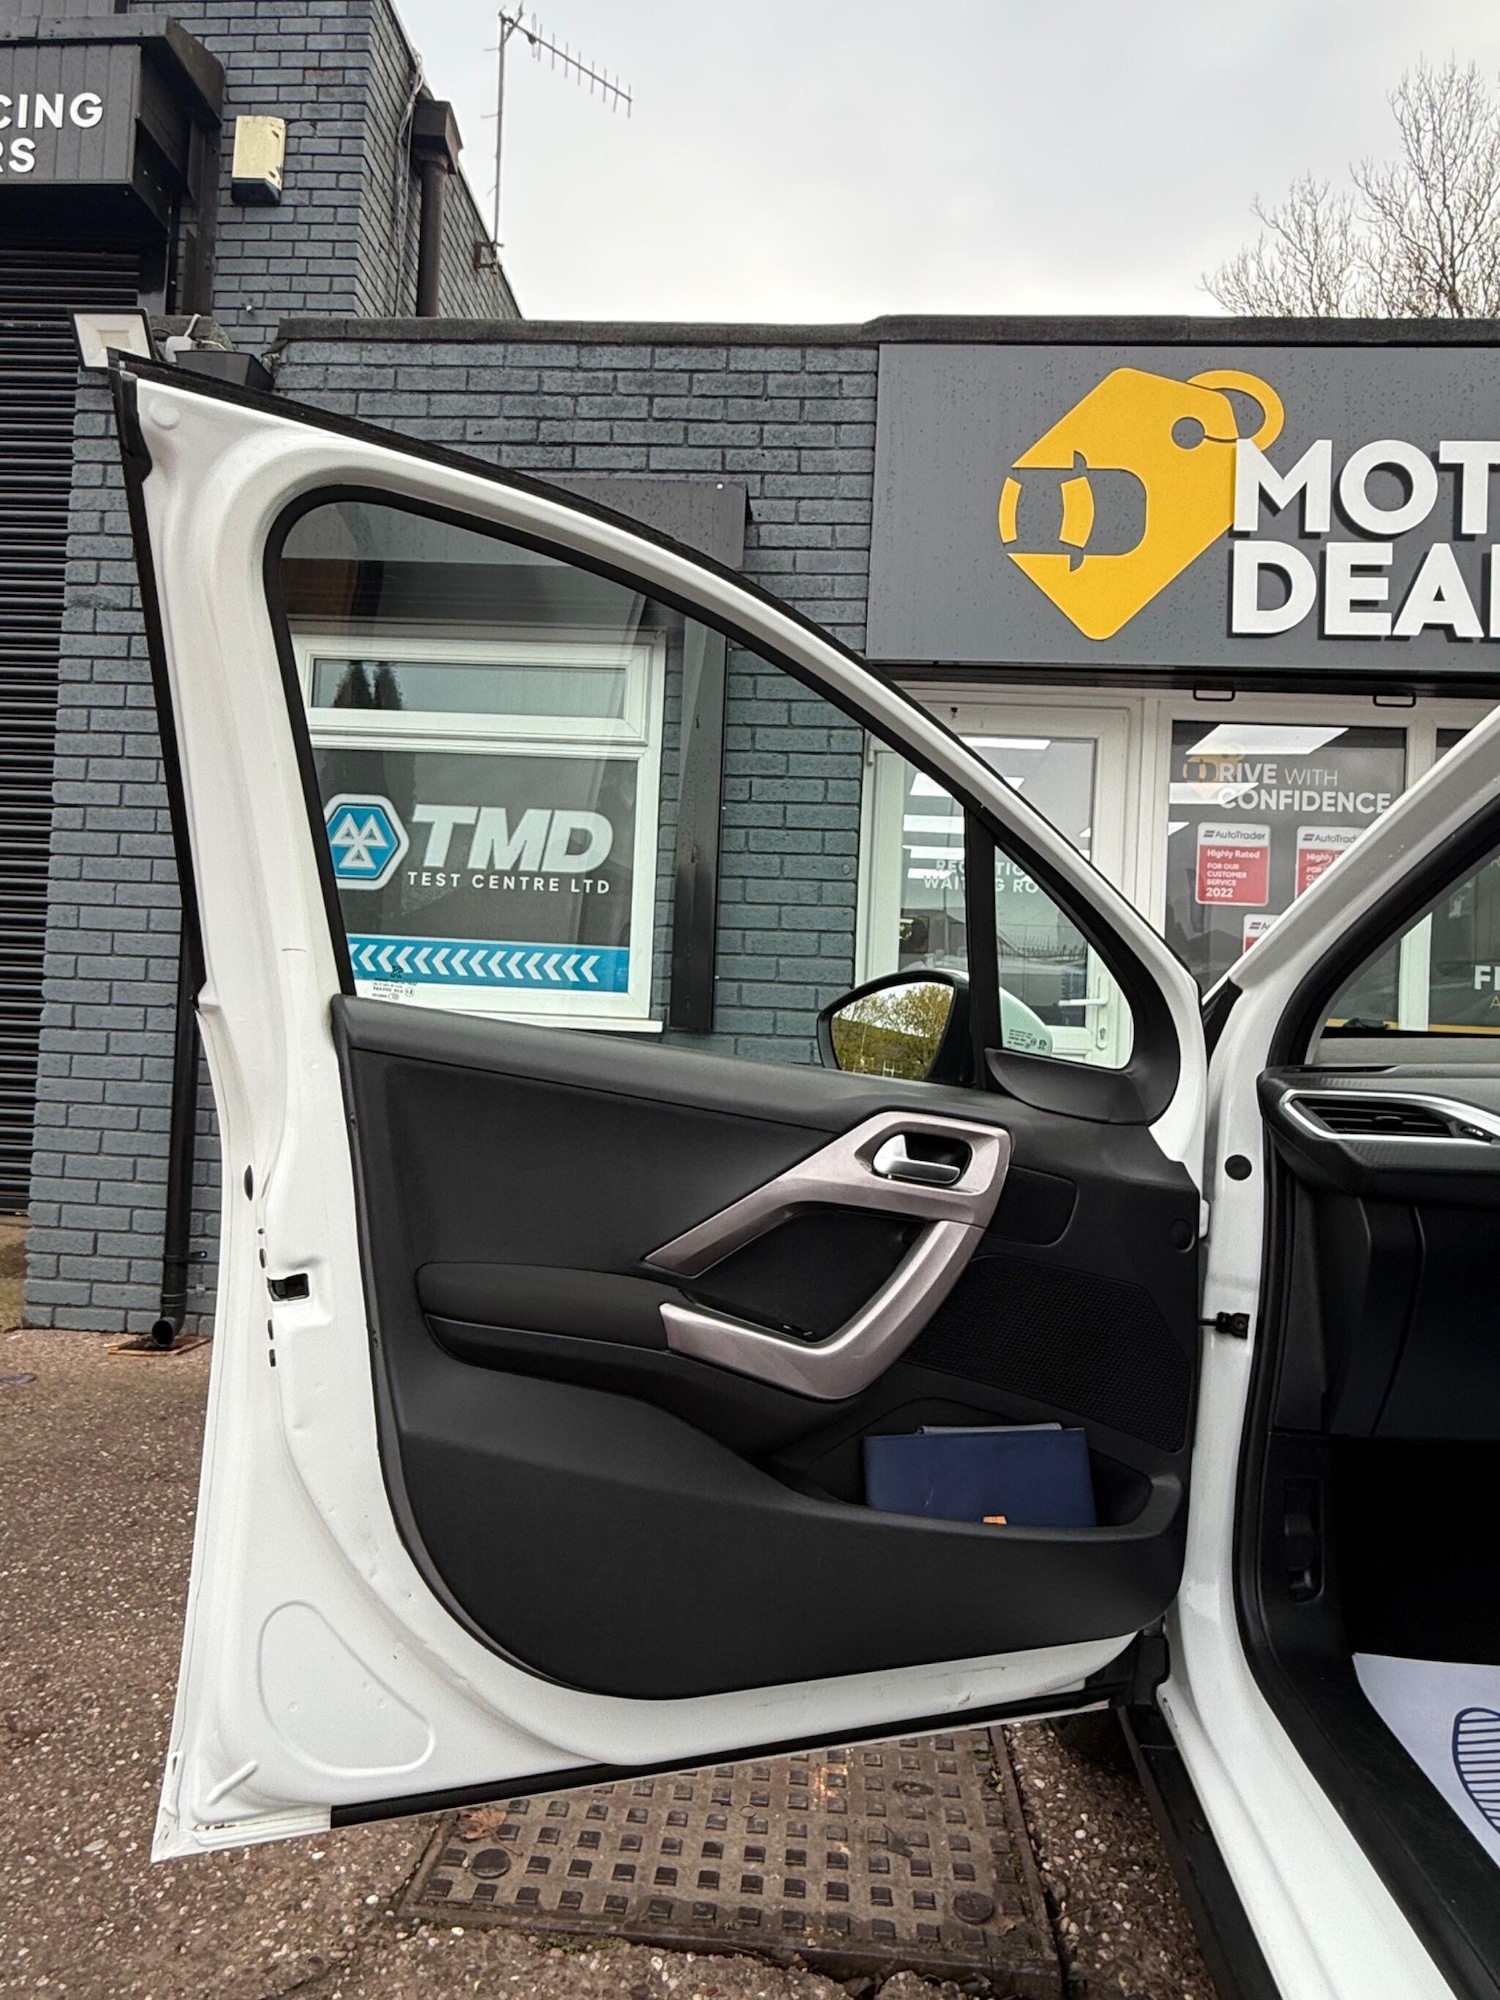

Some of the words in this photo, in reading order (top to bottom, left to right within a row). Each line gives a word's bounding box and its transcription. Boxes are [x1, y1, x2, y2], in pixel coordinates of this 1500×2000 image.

[0, 137, 37, 173] S
[1233, 438, 1500, 535] MOT
[1232, 540, 1500, 639] DEA
[1284, 768, 1338, 787] WITH
[1218, 788, 1391, 814] CONFIDENCE
[411, 803, 614, 873] TMD
[1215, 830, 1266, 841] AutoTrader
[1314, 834, 1357, 844] AutoTrad
[1207, 849, 1233, 859] Highly
[1235, 850, 1260, 859] Rated
[1207, 862, 1222, 870] FOR
[407, 871, 461, 888] TEST
[472, 874, 560, 892] CENTRE
[571, 878, 610, 894] LTD
[1207, 871, 1247, 879] CUSTOMER
[1207, 878, 1237, 887] SERVICE
[1206, 887, 1234, 898] 2022
